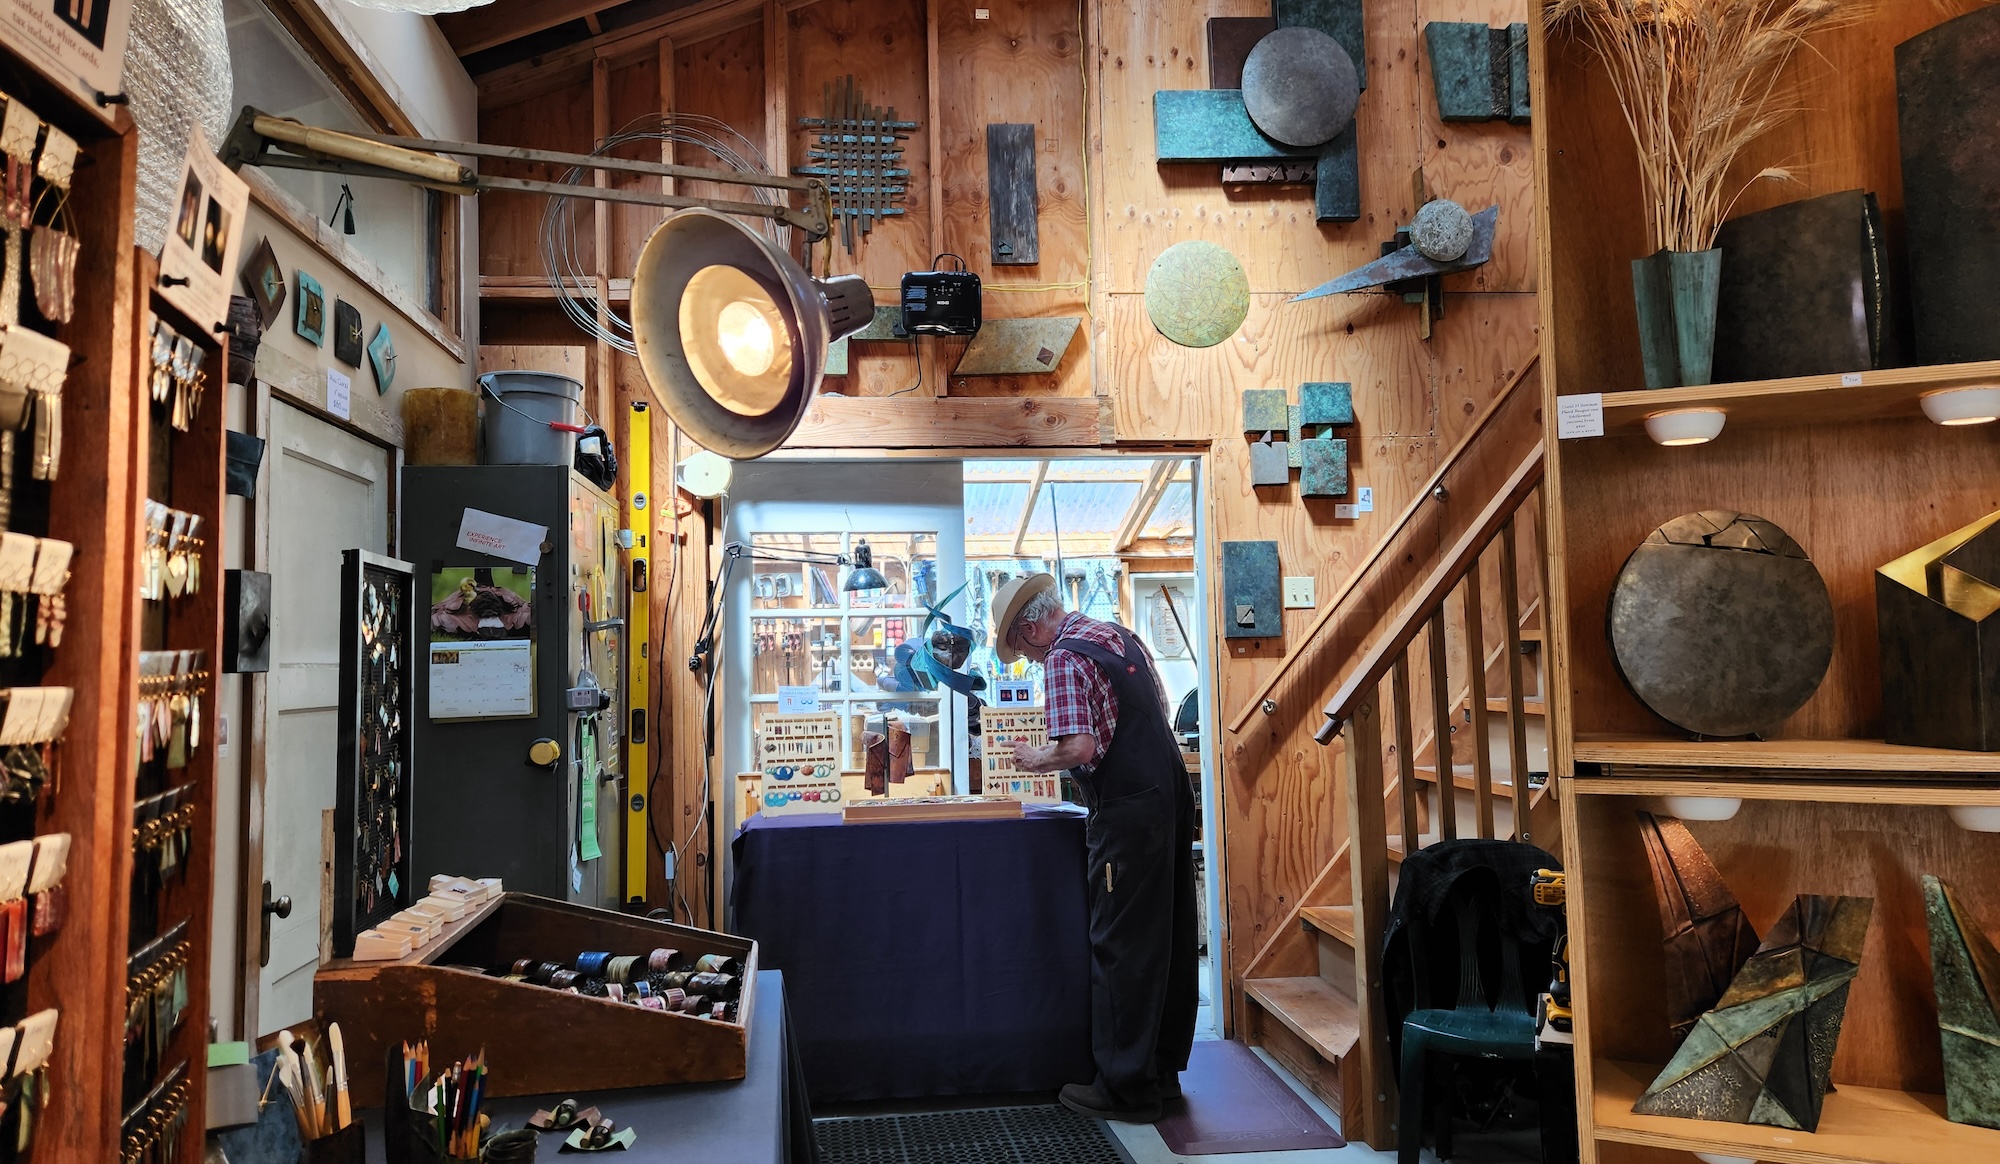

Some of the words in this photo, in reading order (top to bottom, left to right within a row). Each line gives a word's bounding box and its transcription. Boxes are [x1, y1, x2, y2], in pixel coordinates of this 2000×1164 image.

[12, 12, 25, 29] tax
[27, 22, 62, 57] included.
[44, 19, 54, 33] on
[56, 29, 77, 50] white
[466, 530, 503, 544] EXPERIENCE
[468, 537, 492, 547] INFINITE
